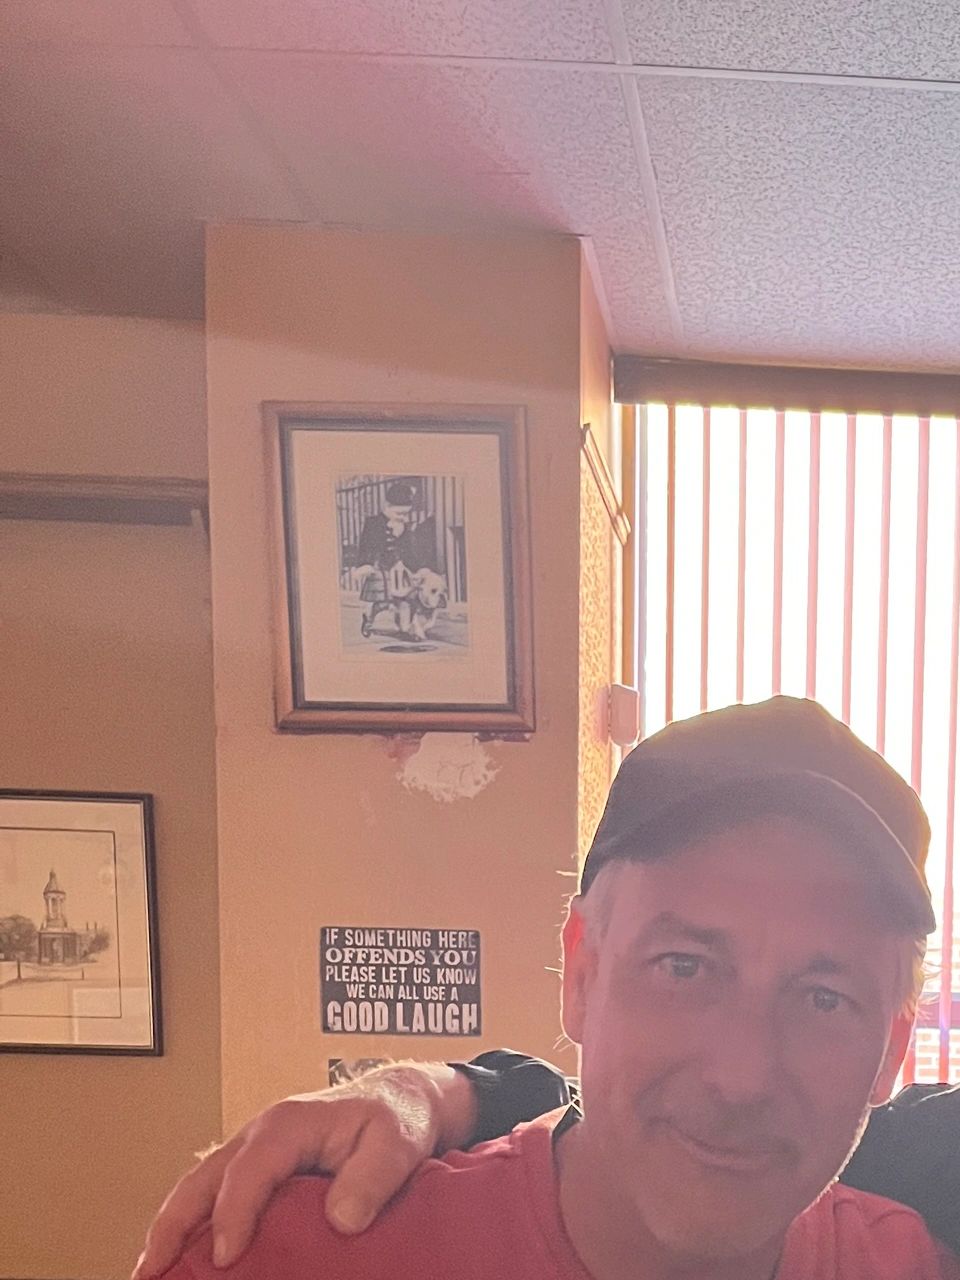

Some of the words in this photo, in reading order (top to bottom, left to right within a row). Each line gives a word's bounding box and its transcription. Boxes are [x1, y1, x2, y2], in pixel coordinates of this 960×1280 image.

[326, 928, 338, 945] IF
[345, 929, 431, 947] SOMETHING
[438, 931, 476, 948] HERE
[326, 948, 425, 965] OFFENDS
[430, 950, 476, 965] YOU
[326, 966, 376, 982] PLEASE
[382, 967, 407, 983] LET
[413, 967, 430, 984] US
[437, 968, 477, 984] KNOW
[346, 984, 365, 999] WE
[369, 985, 393, 999] CAN
[398, 986, 419, 1000] ALL
[424, 986, 445, 1000] USE
[451, 987, 458, 1001] A
[327, 1001, 388, 1032] GOOD
[396, 1002, 477, 1034] LAUGH
